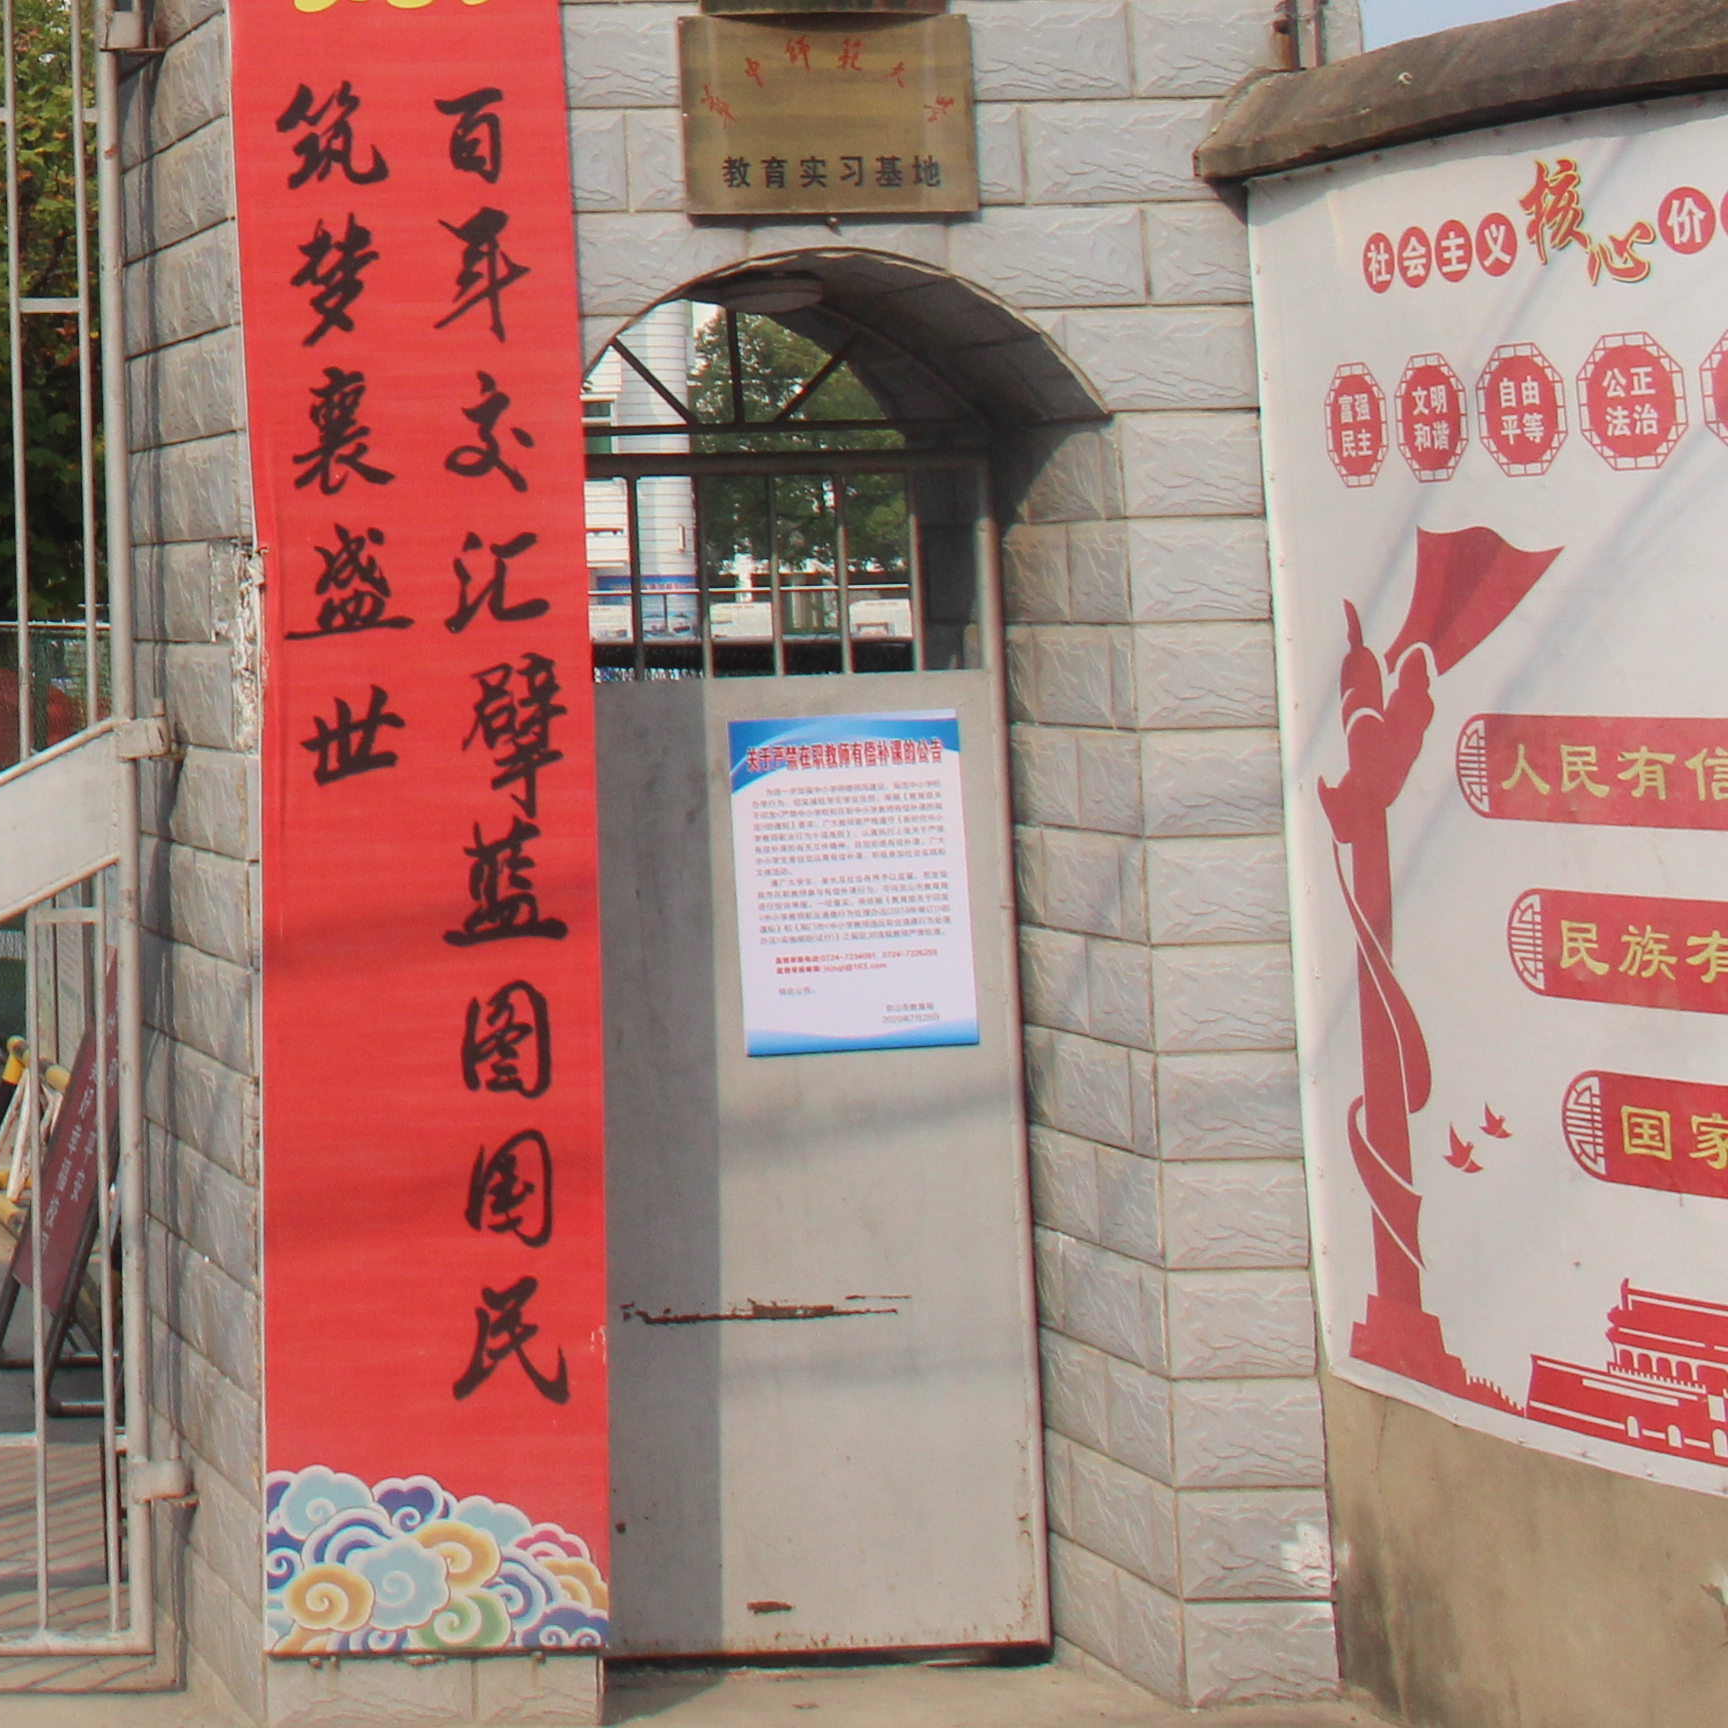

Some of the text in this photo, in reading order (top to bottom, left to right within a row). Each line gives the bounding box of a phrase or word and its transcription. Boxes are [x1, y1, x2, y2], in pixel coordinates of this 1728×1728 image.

[722, 155, 942, 189] 教育实习基地
[1498, 375, 1543, 409] 自由
[1601, 365, 1657, 400] 公正
[1337, 393, 1372, 424] 富强
[1411, 384, 1449, 417] 文明
[276, 80, 414, 786] 筑梦襄盛世
[1413, 420, 1450, 452] 和谐
[1500, 413, 1546, 445] 平等
[1605, 406, 1660, 437] 法治
[1340, 428, 1373, 459] 民主
[746, 737, 943, 772] 关于严禁在职教师有偿补课的公告
[1501, 743, 1728, 802] 人民有信
[1560, 919, 1728, 984] 民族有
[1620, 1104, 1728, 1171] 国家
